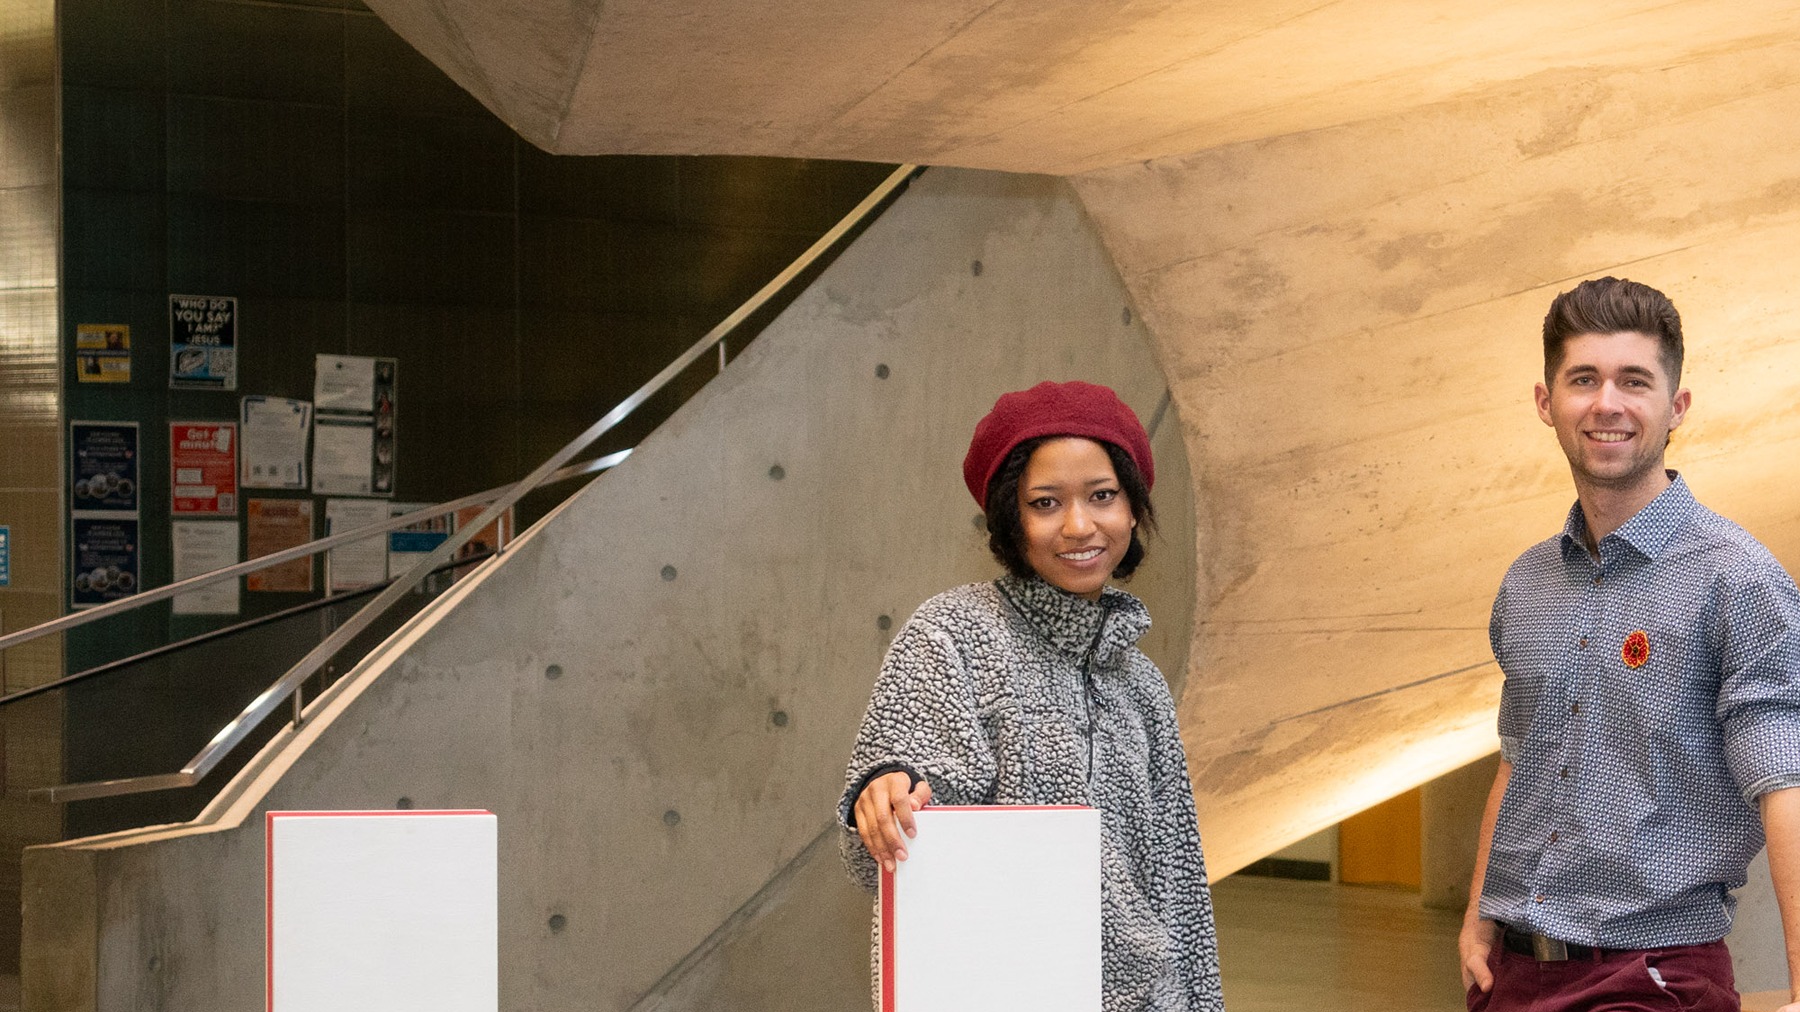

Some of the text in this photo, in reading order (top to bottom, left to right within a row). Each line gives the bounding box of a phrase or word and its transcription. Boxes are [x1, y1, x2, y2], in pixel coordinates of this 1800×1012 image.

[175, 310, 231, 324] YOU SAY
[187, 323, 193, 334] I
[187, 428, 210, 440] Get
